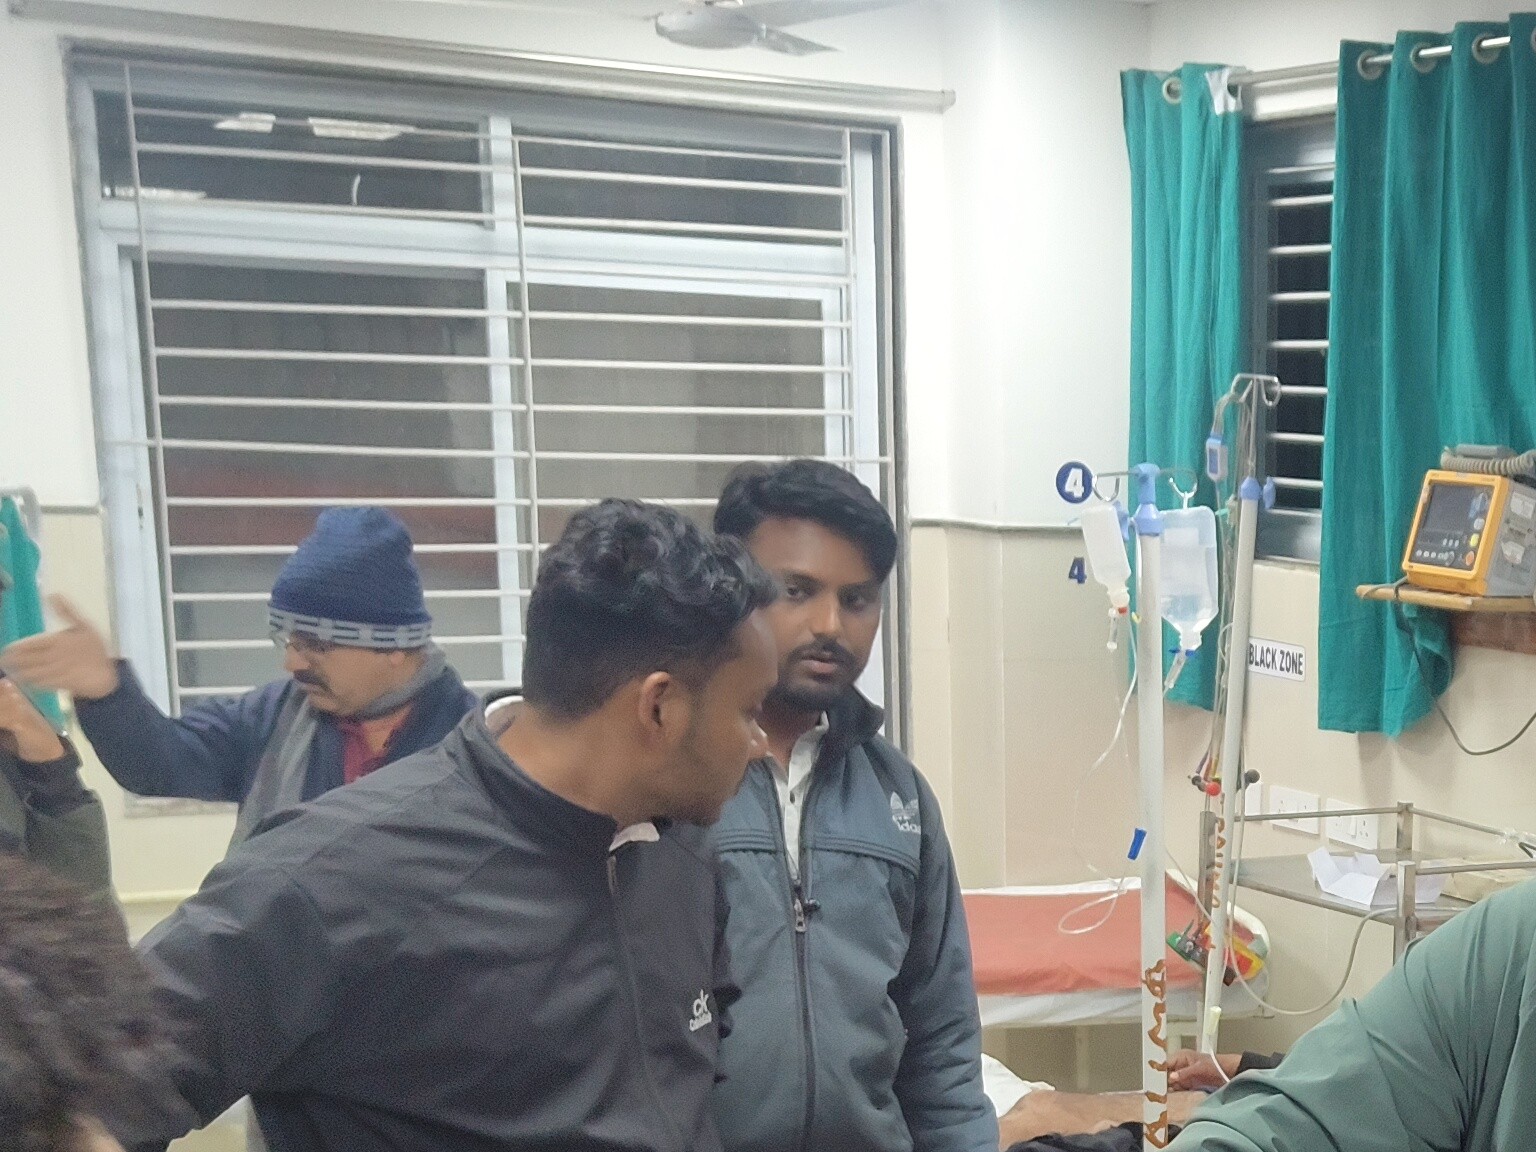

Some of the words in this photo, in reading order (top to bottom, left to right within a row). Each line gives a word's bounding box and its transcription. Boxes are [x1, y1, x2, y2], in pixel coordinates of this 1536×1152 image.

[1064, 467, 1085, 498] 4
[1068, 556, 1087, 584] 4
[1249, 642, 1277, 670] BLACK
[1279, 649, 1304, 675] ZONE
